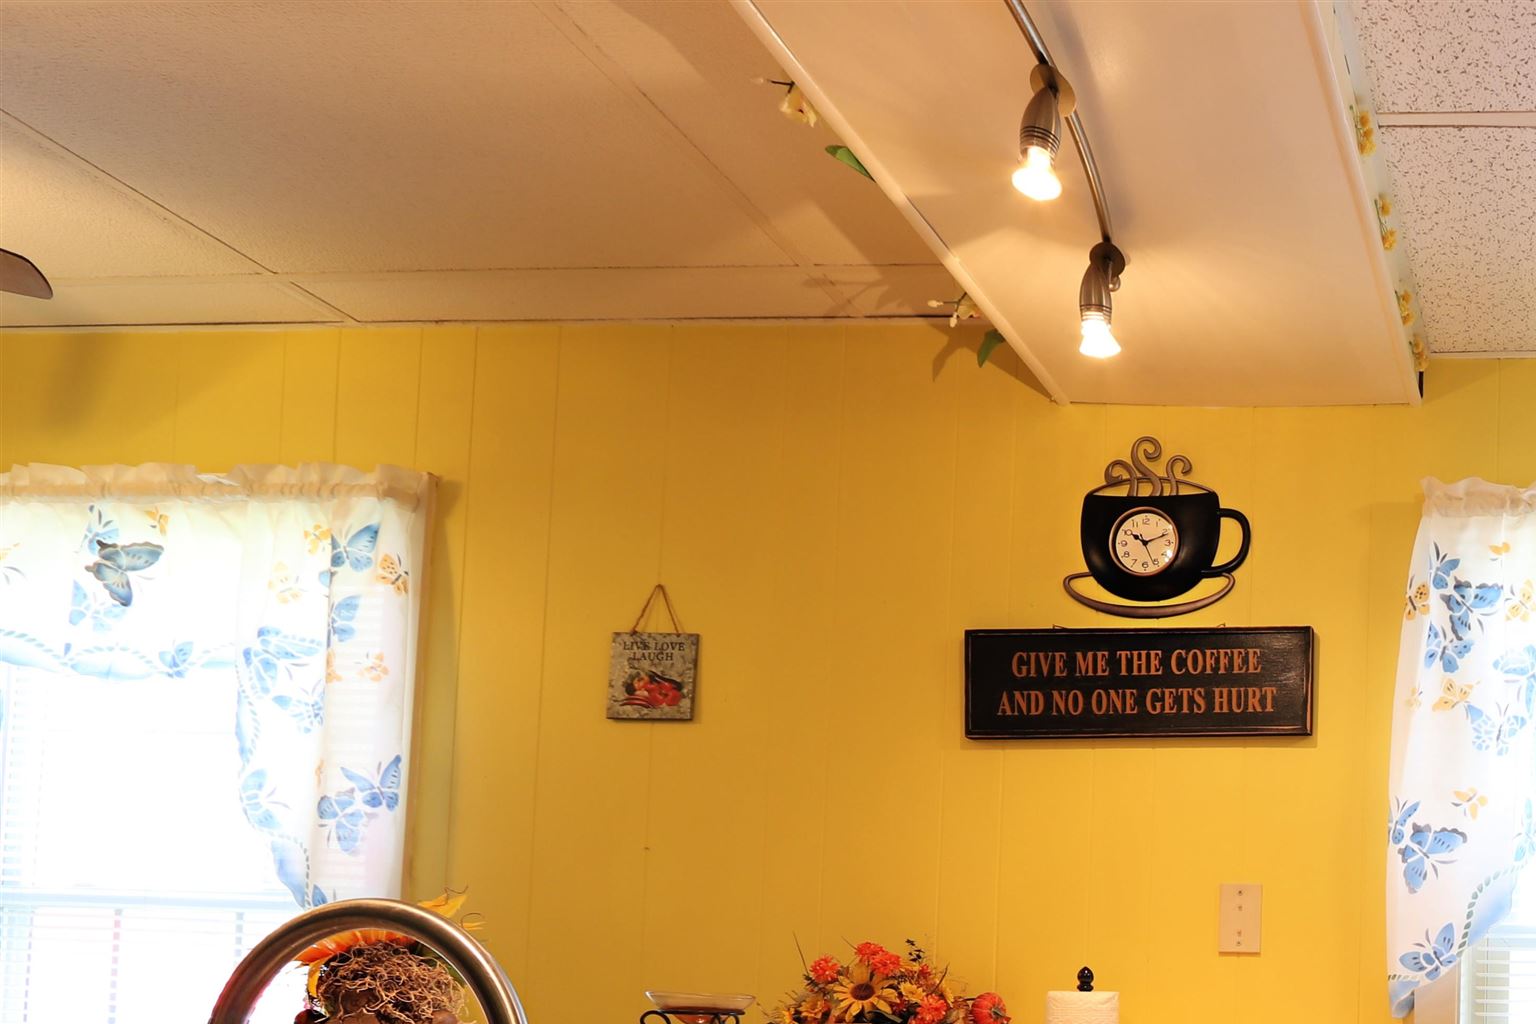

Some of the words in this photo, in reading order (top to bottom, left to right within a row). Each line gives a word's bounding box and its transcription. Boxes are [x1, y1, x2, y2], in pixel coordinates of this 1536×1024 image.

[1131, 519, 1138, 528] 11
[1164, 539, 1171, 547] 3
[1131, 559, 1138, 568] 7
[1141, 561, 1149, 569] 6
[623, 641, 650, 651] LIVE
[654, 642, 685, 652] LOVE
[632, 652, 674, 662] LAUGH
[1011, 651, 1068, 678] GIVE
[1075, 651, 1110, 677] ME
[1117, 649, 1164, 676] THE
[1170, 648, 1262, 675] COFFEE
[997, 690, 1046, 716] AND
[1051, 689, 1084, 716] NO
[1091, 688, 1139, 715] ONE
[1145, 687, 1207, 715] GETS
[1212, 686, 1277, 713] HURT
